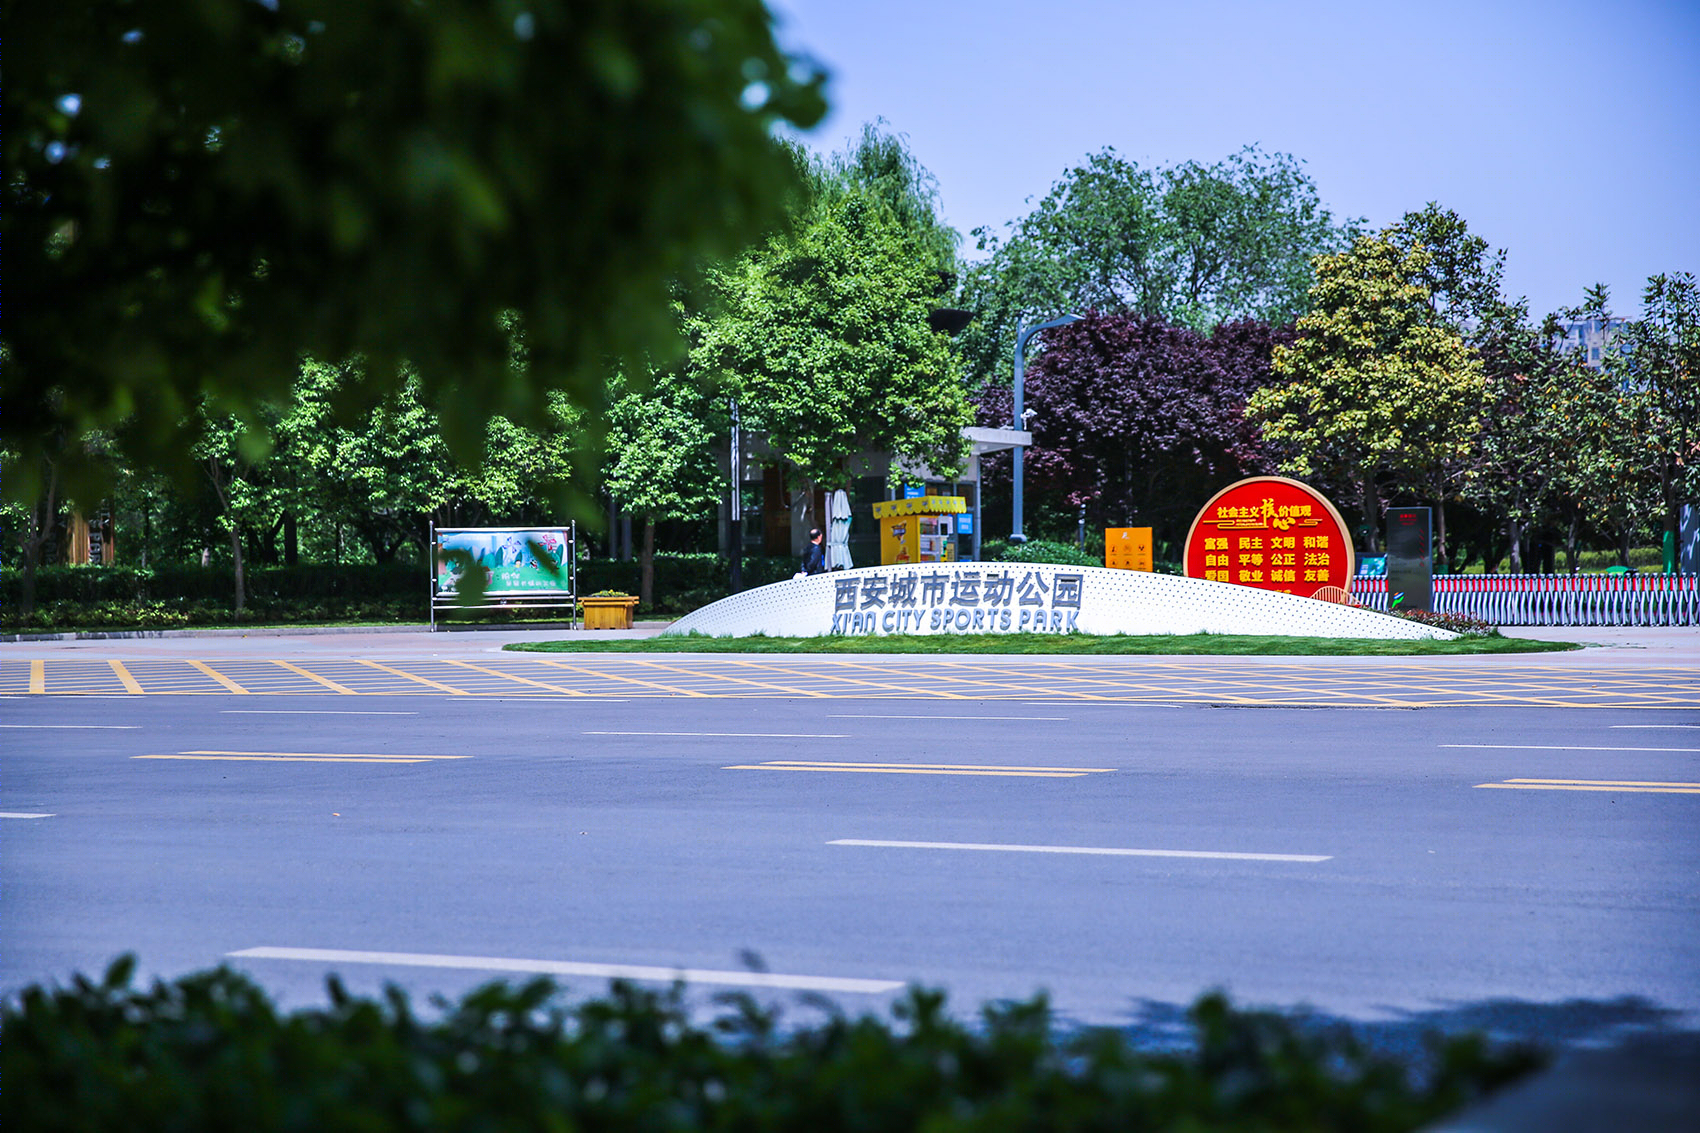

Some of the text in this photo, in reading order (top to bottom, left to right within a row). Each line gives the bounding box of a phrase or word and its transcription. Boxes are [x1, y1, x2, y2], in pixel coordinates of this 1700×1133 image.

[1204, 535, 1329, 551] 富强 民主 文明 和谐
[1205, 552, 1330, 567] 自由 平等 公正 法治
[1238, 569, 1264, 583] 敬业
[1270, 569, 1296, 582] 诚信
[1303, 568, 1330, 582] 友善
[834, 570, 1083, 612] 西安城市运动公园
[882, 609, 926, 632] CITY
[930, 608, 1012, 631] SPORTS
[1019, 608, 1080, 632] PARK
